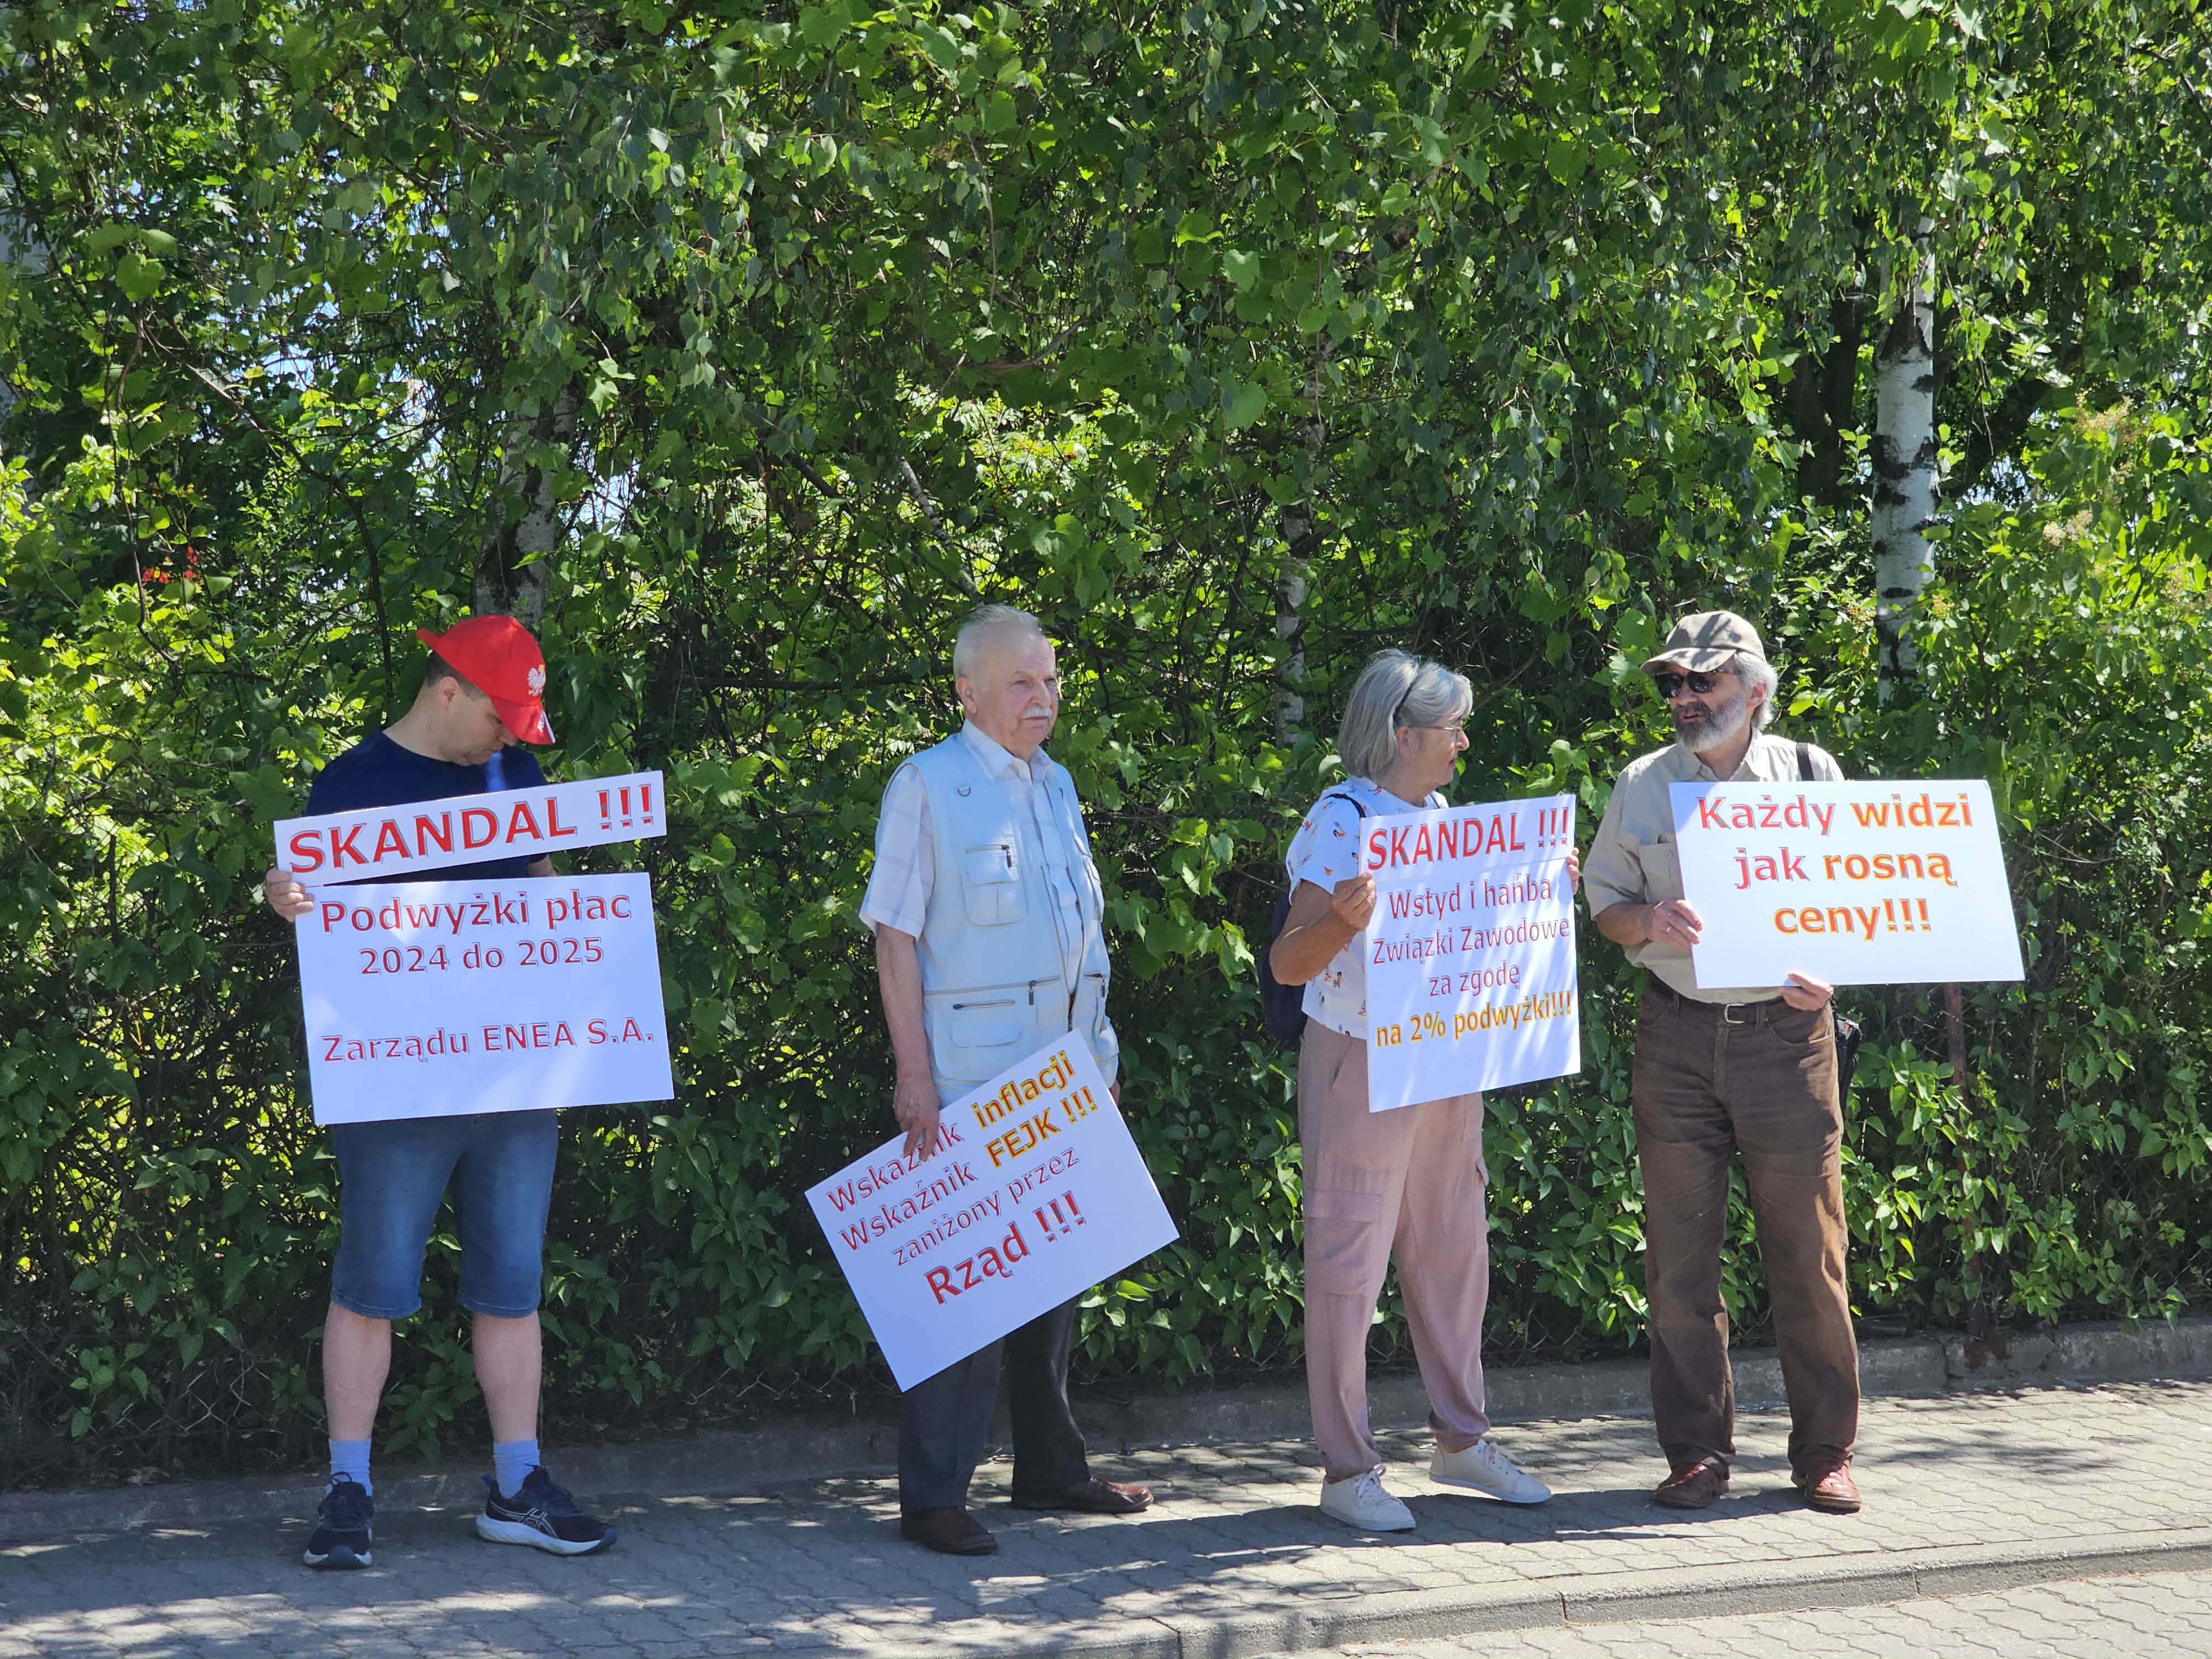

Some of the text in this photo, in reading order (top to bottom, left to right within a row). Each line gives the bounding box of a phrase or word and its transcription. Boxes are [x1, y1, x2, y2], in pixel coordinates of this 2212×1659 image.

[288, 782, 655, 874] SKANDAL !!!
[1367, 806, 1569, 872] SKANDAL !!!
[1696, 792, 1973, 838] Każdy widzi
[1733, 846, 1958, 890] jak rosną
[319, 888, 632, 936] Podwyżki płac
[1389, 873, 1552, 921] Wstyd i hańba
[1773, 898, 1932, 942] ceny!!!
[358, 936, 604, 976] 2024 do 2025
[1371, 917, 1571, 965] Związki Zawodowe
[1429, 959, 1521, 998] za zgodę
[321, 1016, 655, 1063] Zarządu ENEA S.A.
[1375, 990, 1572, 1048] na 2% podwyżki!!!
[971, 1050, 1076, 1129] inflacji
[839, 1086, 1098, 1252] Wskaźnik FEJK !!!
[891, 1147, 1079, 1266] zaniżony przez
[924, 1190, 1087, 1305] Rząd !!!
